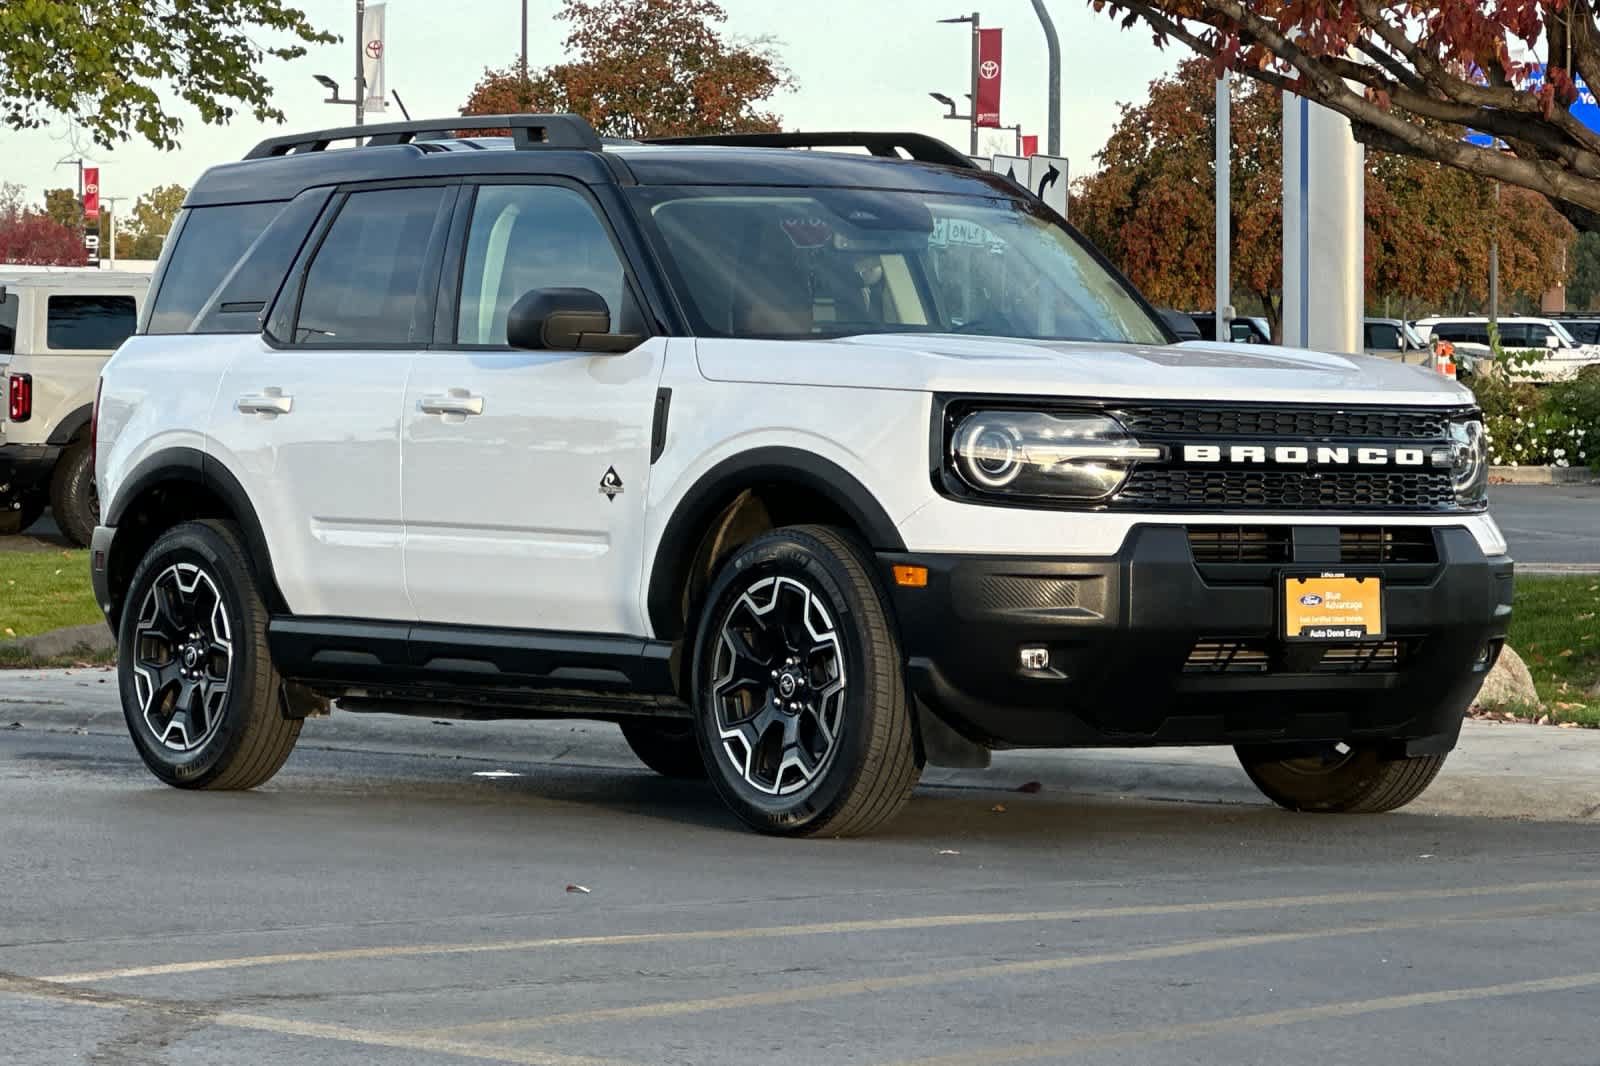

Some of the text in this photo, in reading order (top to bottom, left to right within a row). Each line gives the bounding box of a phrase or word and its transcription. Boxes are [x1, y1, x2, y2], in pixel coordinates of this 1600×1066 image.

[952, 225, 980, 239] ONLY
[1183, 445, 1424, 465] BRONCO
[1325, 601, 1363, 611] Advantage
[1310, 629, 1362, 639] Auto Done Easy
